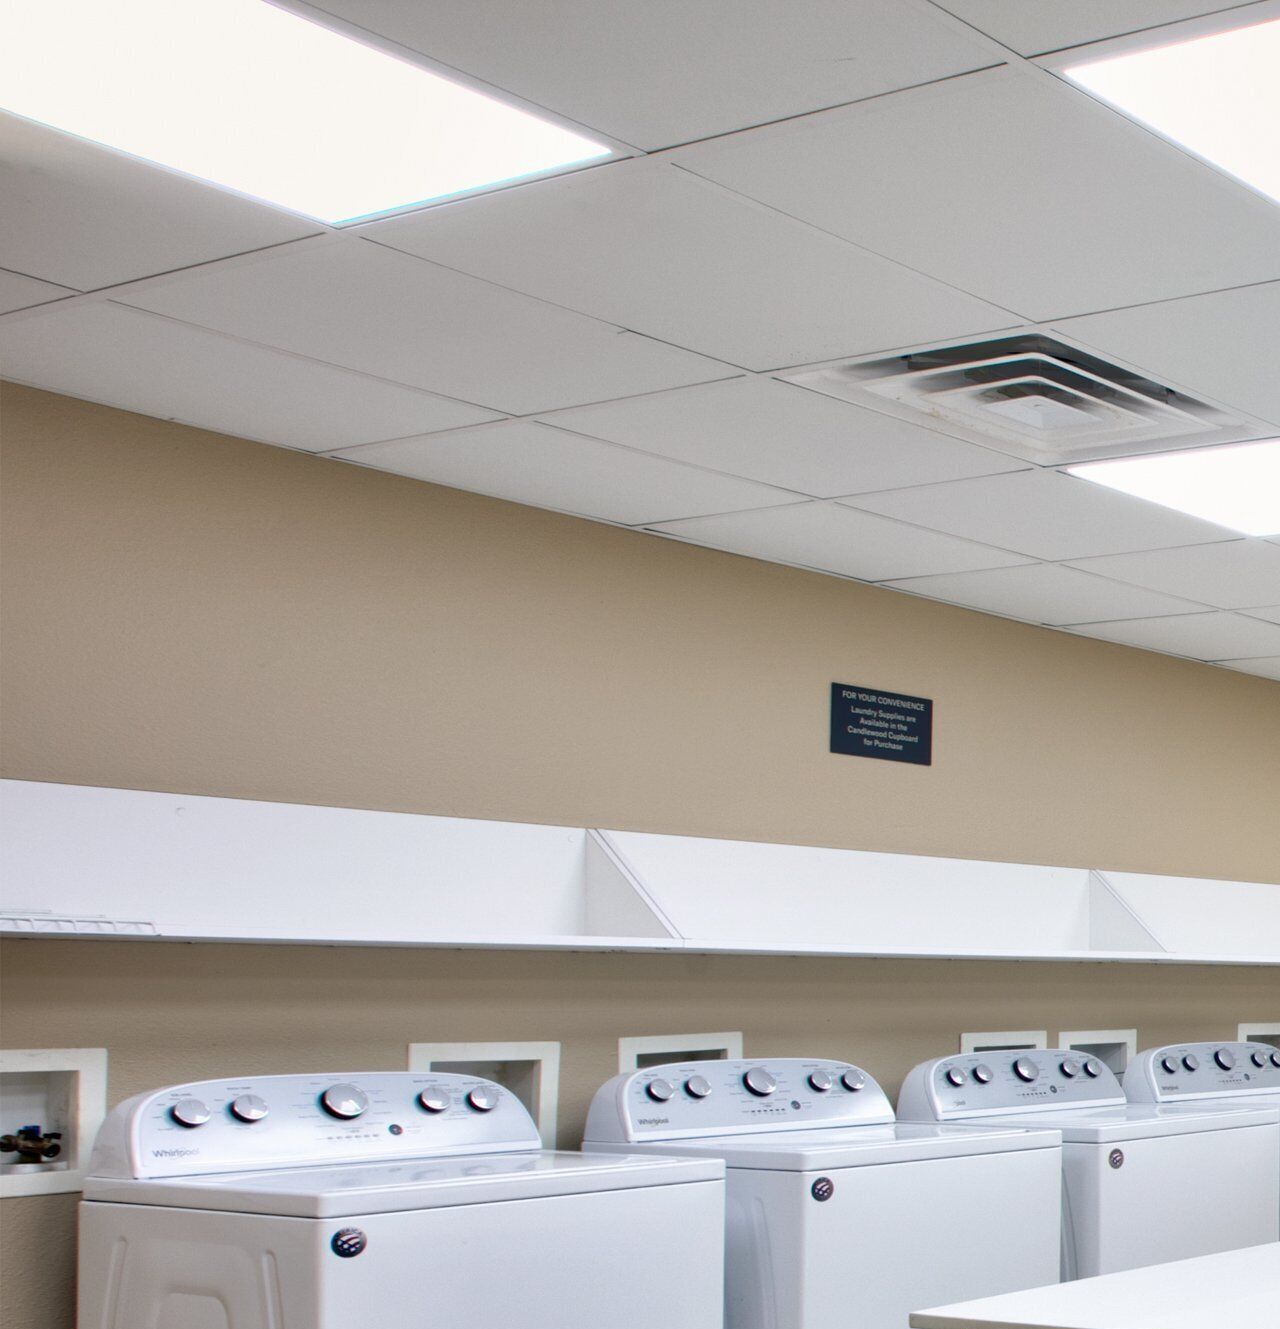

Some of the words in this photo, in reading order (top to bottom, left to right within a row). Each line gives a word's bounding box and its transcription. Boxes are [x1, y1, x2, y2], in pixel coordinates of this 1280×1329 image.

[842, 690, 857, 699] FOR
[858, 693, 877, 703] YOUR
[877, 696, 925, 711] CONVENIENCE
[851, 705, 877, 717] Laundry
[878, 710, 905, 721] Supplies
[859, 717, 889, 729] Available
[890, 721, 896, 729] in
[847, 725, 887, 738] Candlewood
[888, 731, 918, 742] Cupboard
[863, 738, 873, 746] for
[874, 739, 903, 750] Purchase
[152, 1148, 200, 1160] Whirlpool
